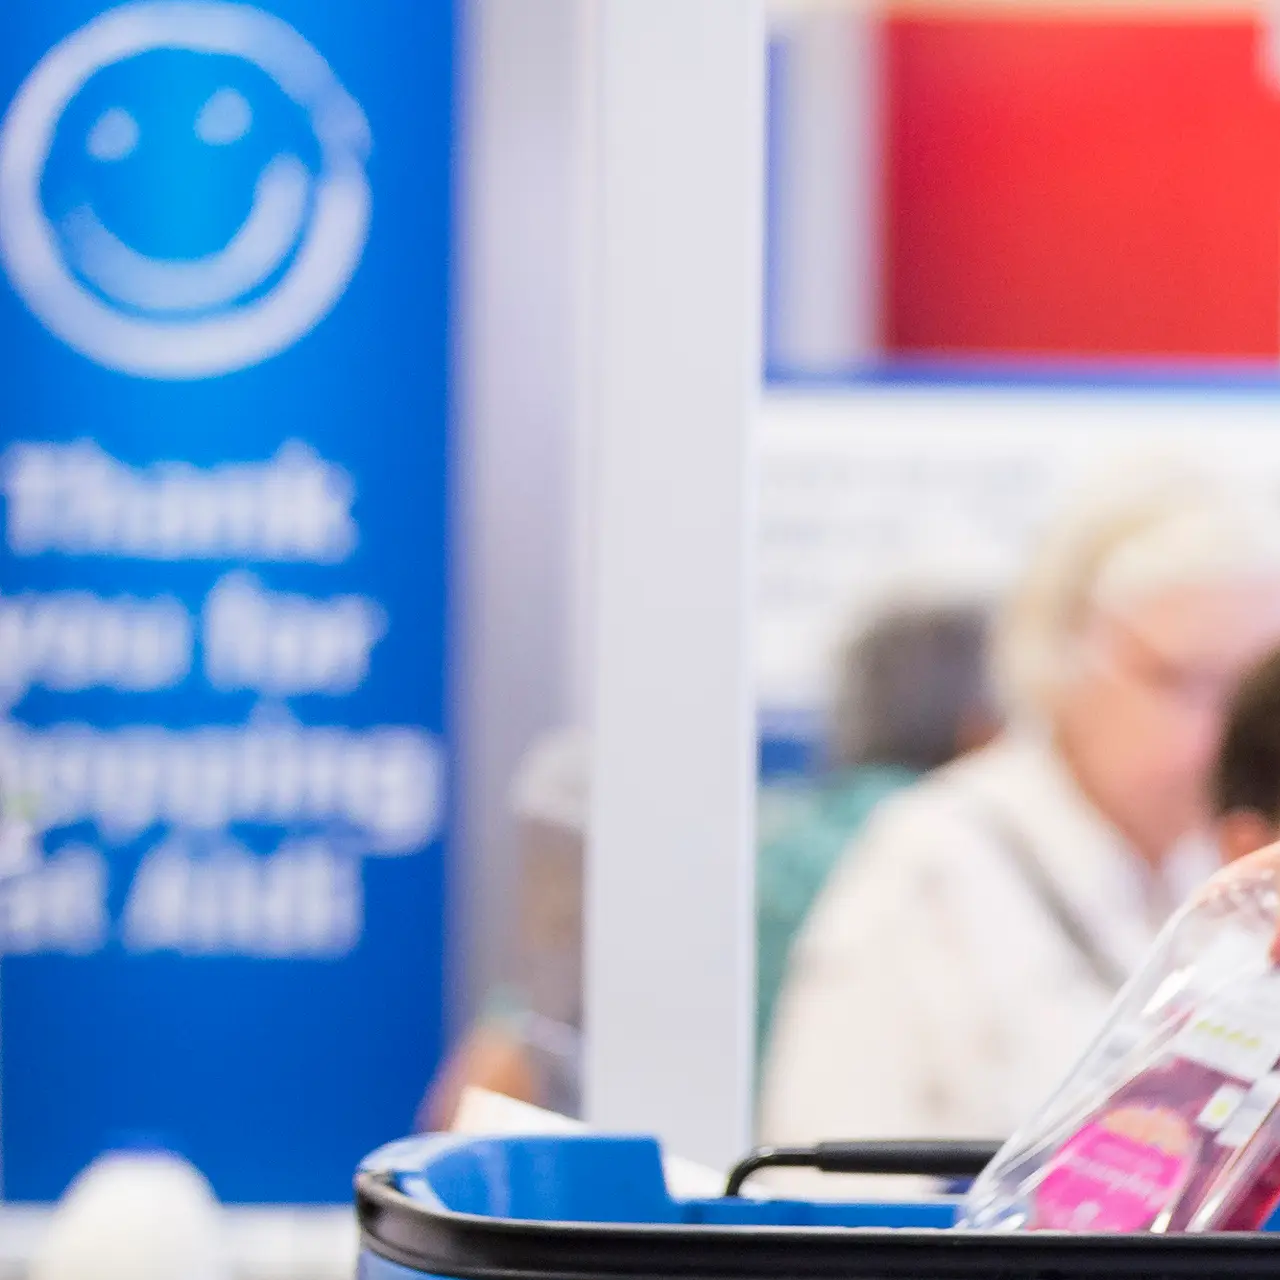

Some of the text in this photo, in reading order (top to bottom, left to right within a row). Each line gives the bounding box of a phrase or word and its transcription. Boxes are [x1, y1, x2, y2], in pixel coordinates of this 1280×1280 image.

[8, 440, 354, 560] Thank
[207, 573, 384, 692] for
[125, 842, 360, 956] Aldi
